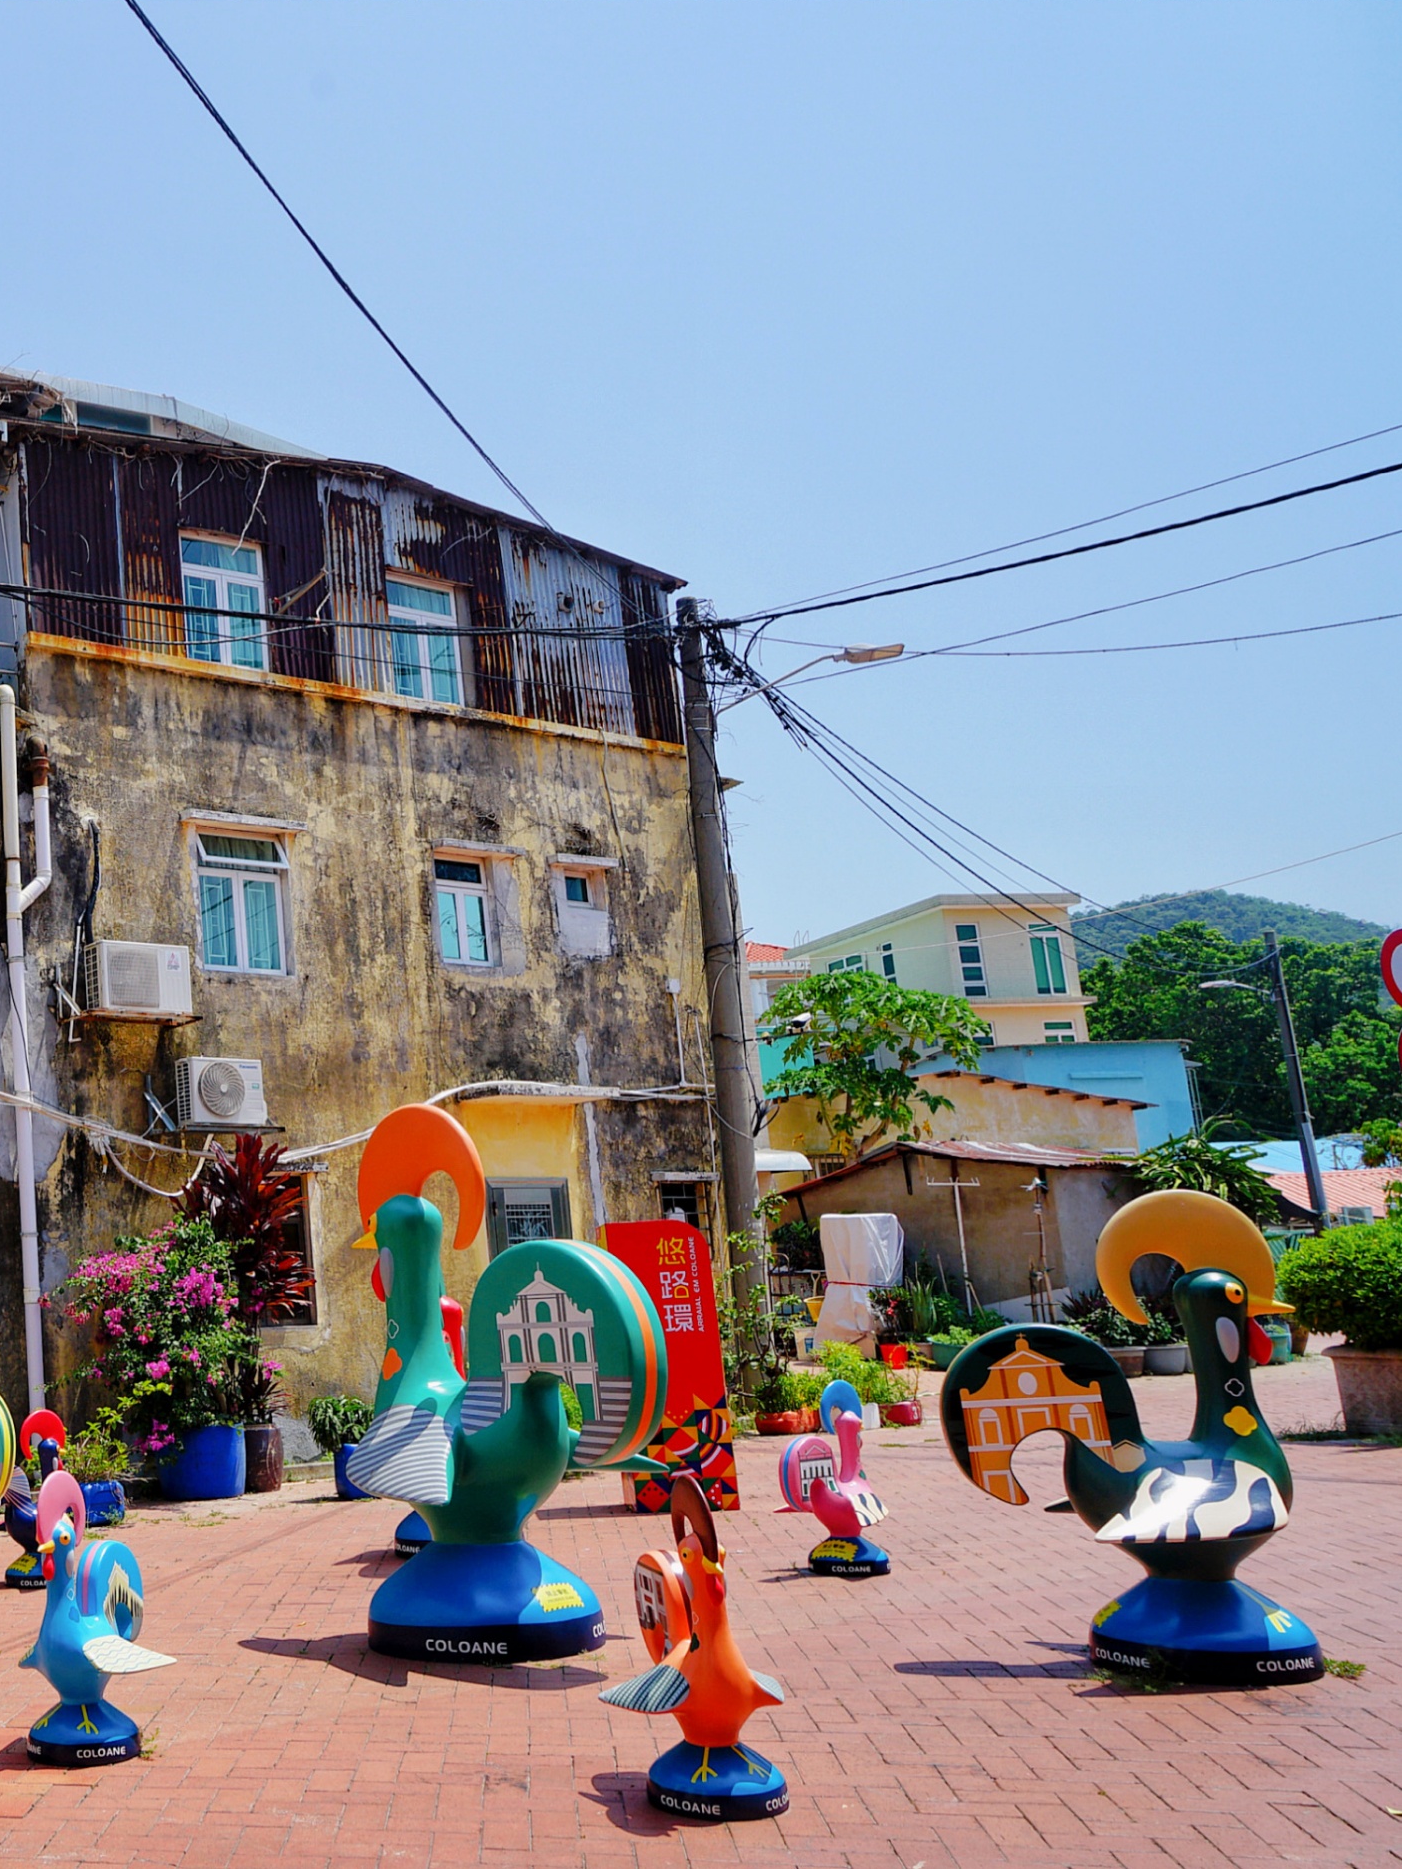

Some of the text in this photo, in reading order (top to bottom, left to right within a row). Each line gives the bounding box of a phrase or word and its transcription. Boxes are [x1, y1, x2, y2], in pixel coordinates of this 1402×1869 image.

[656, 1236, 695, 1333] 悠路環
[688, 1236, 705, 1333] ARRAIAL EM COLOANE
[831, 1565, 872, 1573] COLOANE
[424, 1638, 508, 1655] COLOANE
[1095, 1646, 1151, 1669] COLOANE
[1255, 1656, 1316, 1672] COLOANE
[76, 1745, 127, 1759] COLOANE
[660, 1794, 722, 1816] COLOANE
[765, 1792, 790, 1812] COLOA
